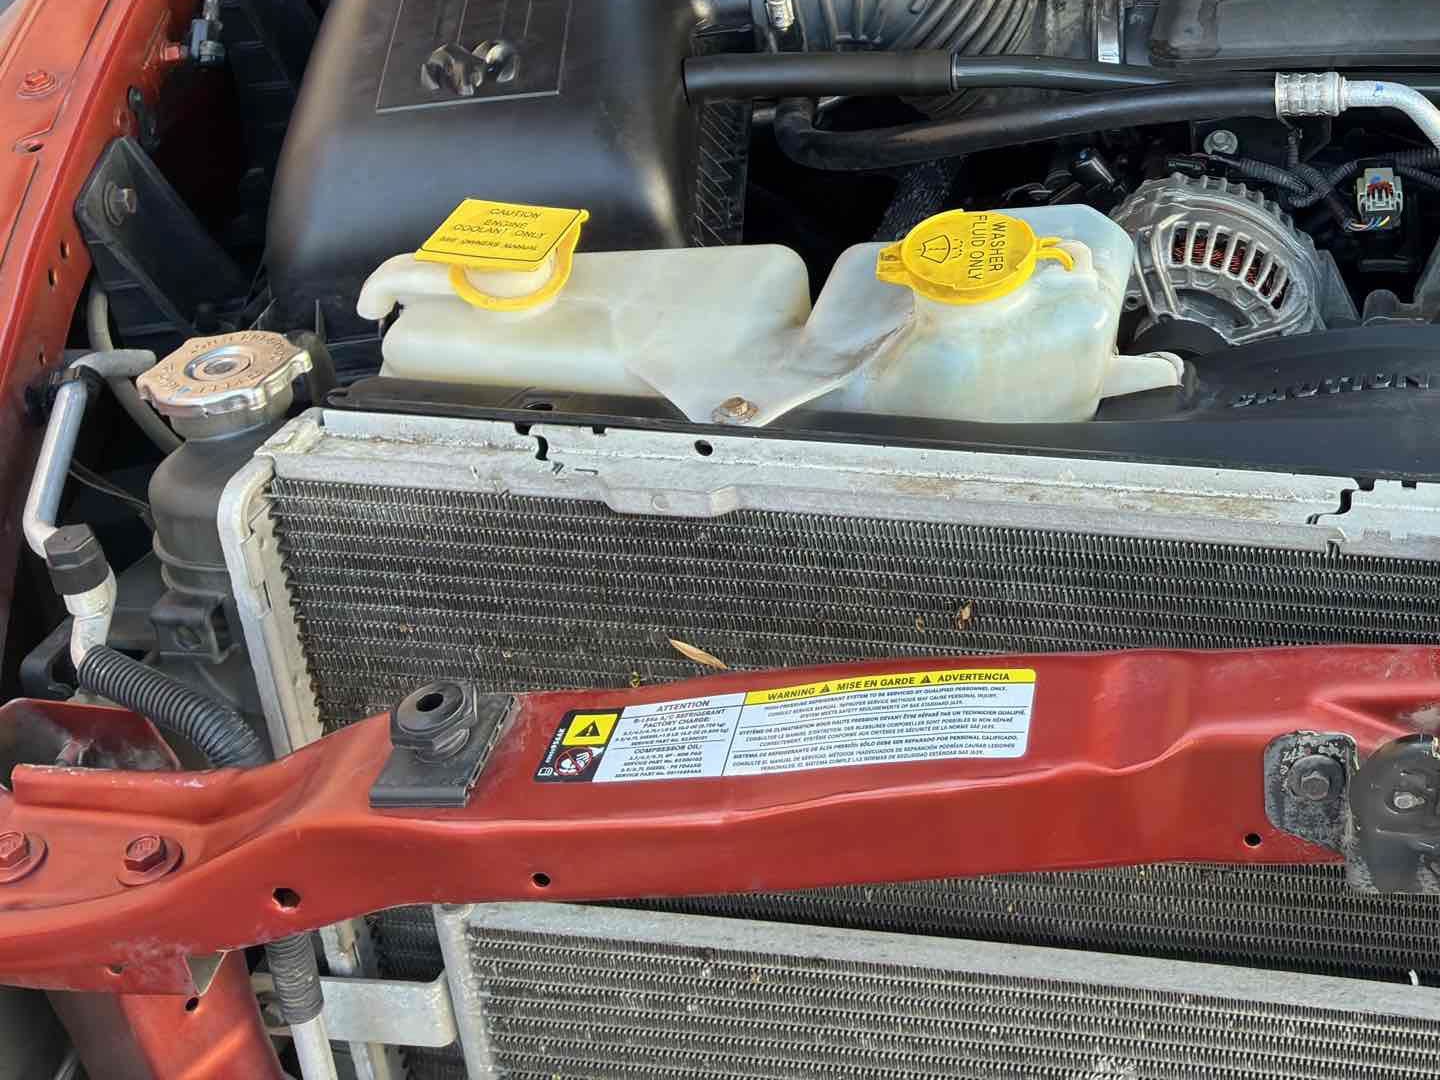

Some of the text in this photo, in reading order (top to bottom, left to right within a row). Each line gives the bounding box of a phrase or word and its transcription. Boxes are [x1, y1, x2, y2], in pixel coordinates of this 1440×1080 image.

[489, 208, 542, 218] CAUTION
[967, 214, 988, 280] FLUID ONLY
[989, 221, 1007, 273] WASHER
[767, 673, 1010, 701] WARNING MISE EN GARDE ADVERTENCIA
[656, 700, 711, 712] ATTENTION
